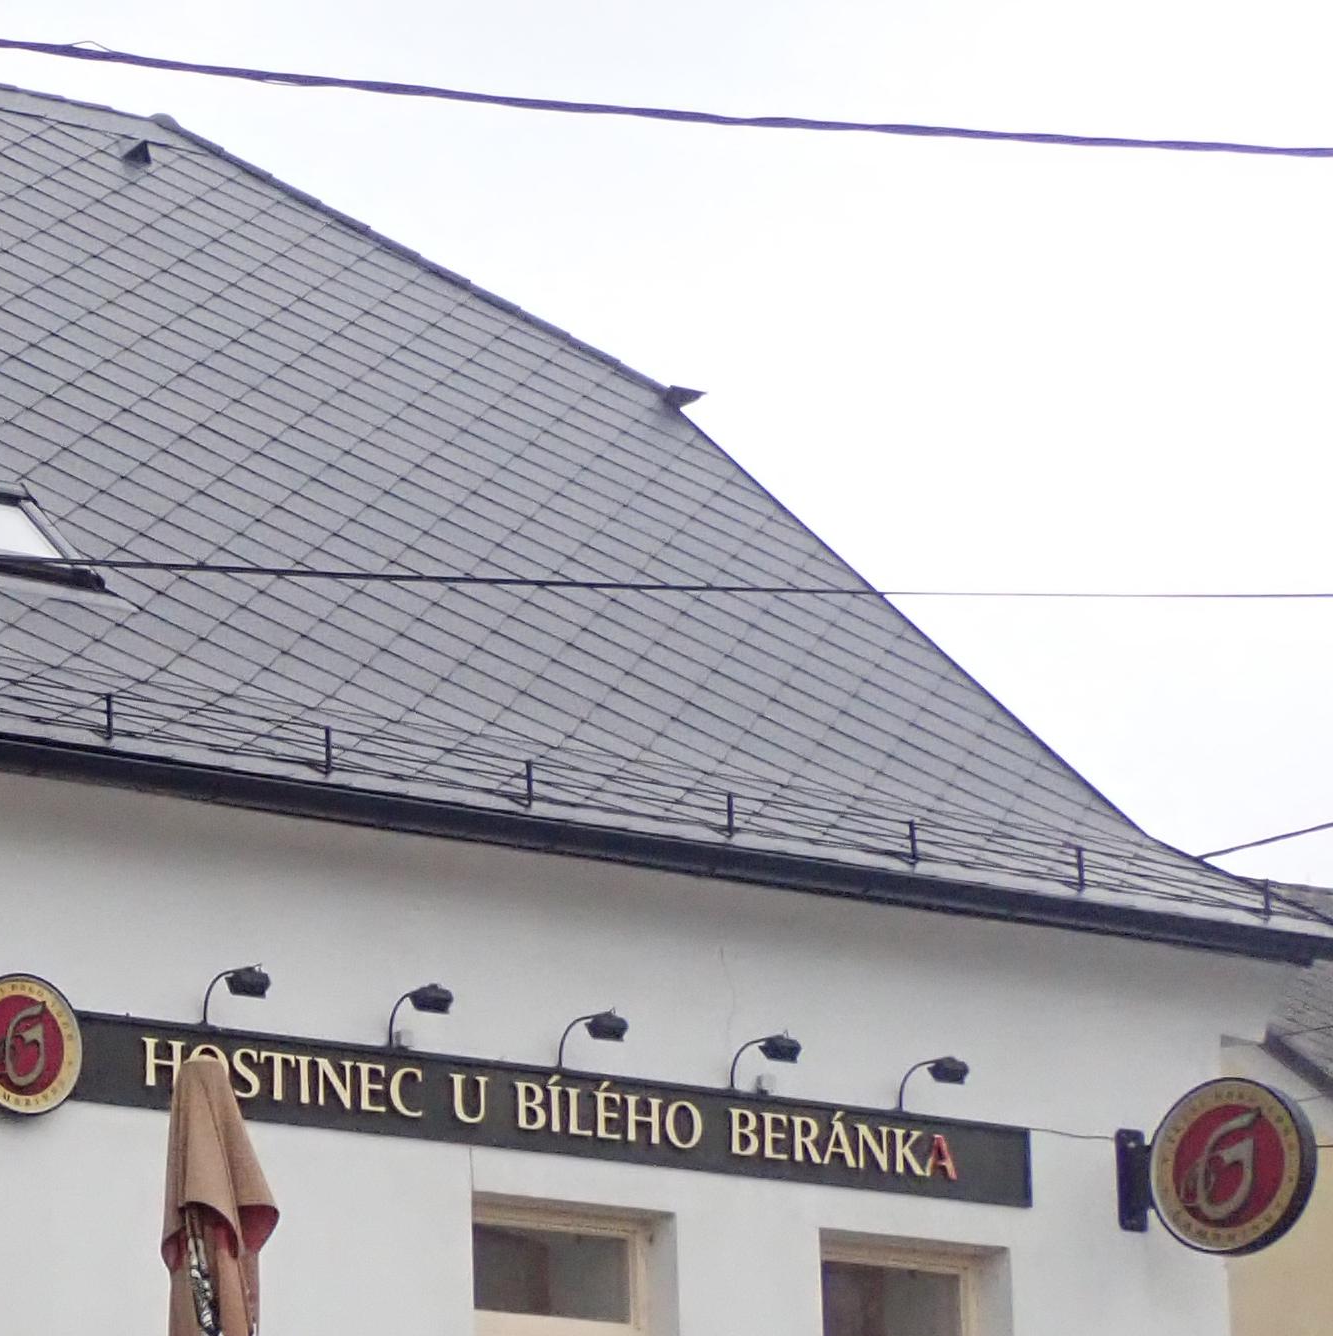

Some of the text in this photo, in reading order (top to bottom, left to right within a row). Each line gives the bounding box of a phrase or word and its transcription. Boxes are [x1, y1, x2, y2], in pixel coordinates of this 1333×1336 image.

[450, 1073, 489, 1125] U
[514, 1074, 703, 1149] BÍLÉHO
[729, 1106, 957, 1181] BERÁNKA
